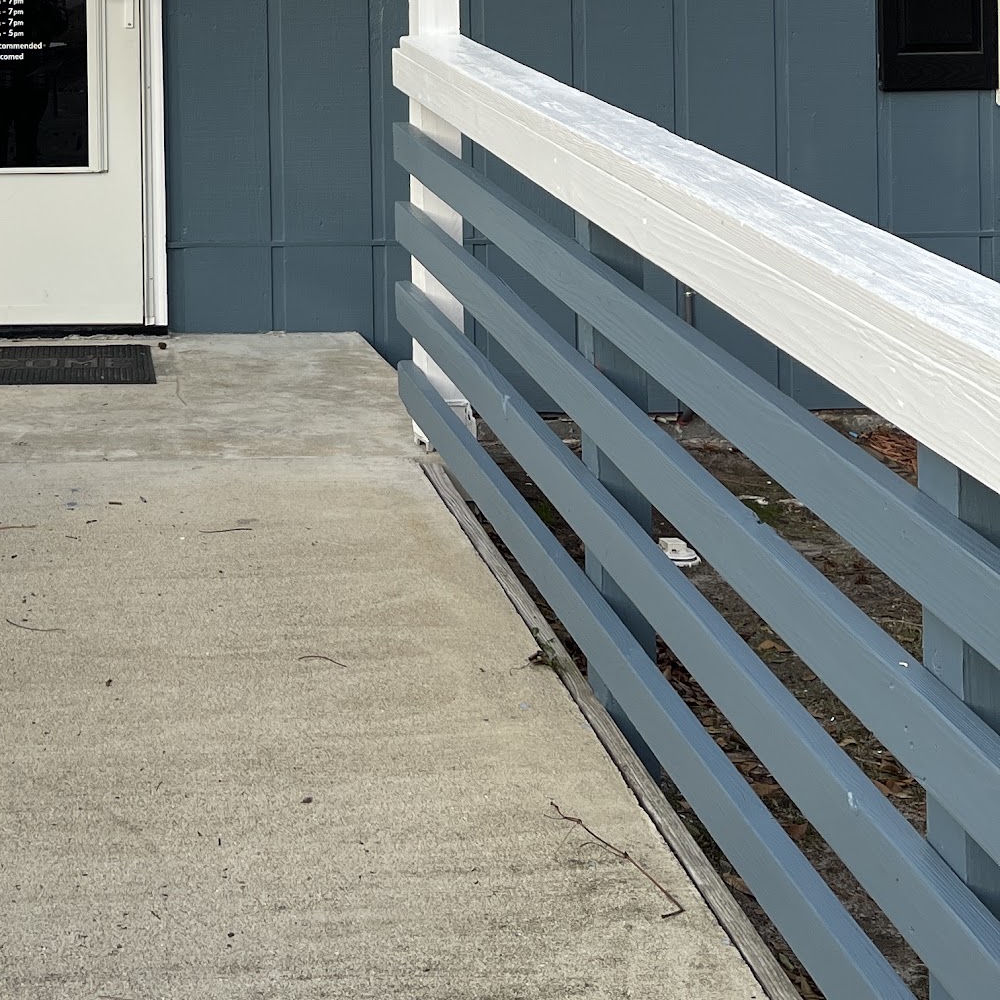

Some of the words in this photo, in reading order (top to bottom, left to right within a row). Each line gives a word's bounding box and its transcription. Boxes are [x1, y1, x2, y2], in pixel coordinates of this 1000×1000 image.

[8, 8, 24, 16] 7pm
[8, 18, 24, 27] 7pm
[8, 29, 24, 38] 5pm
